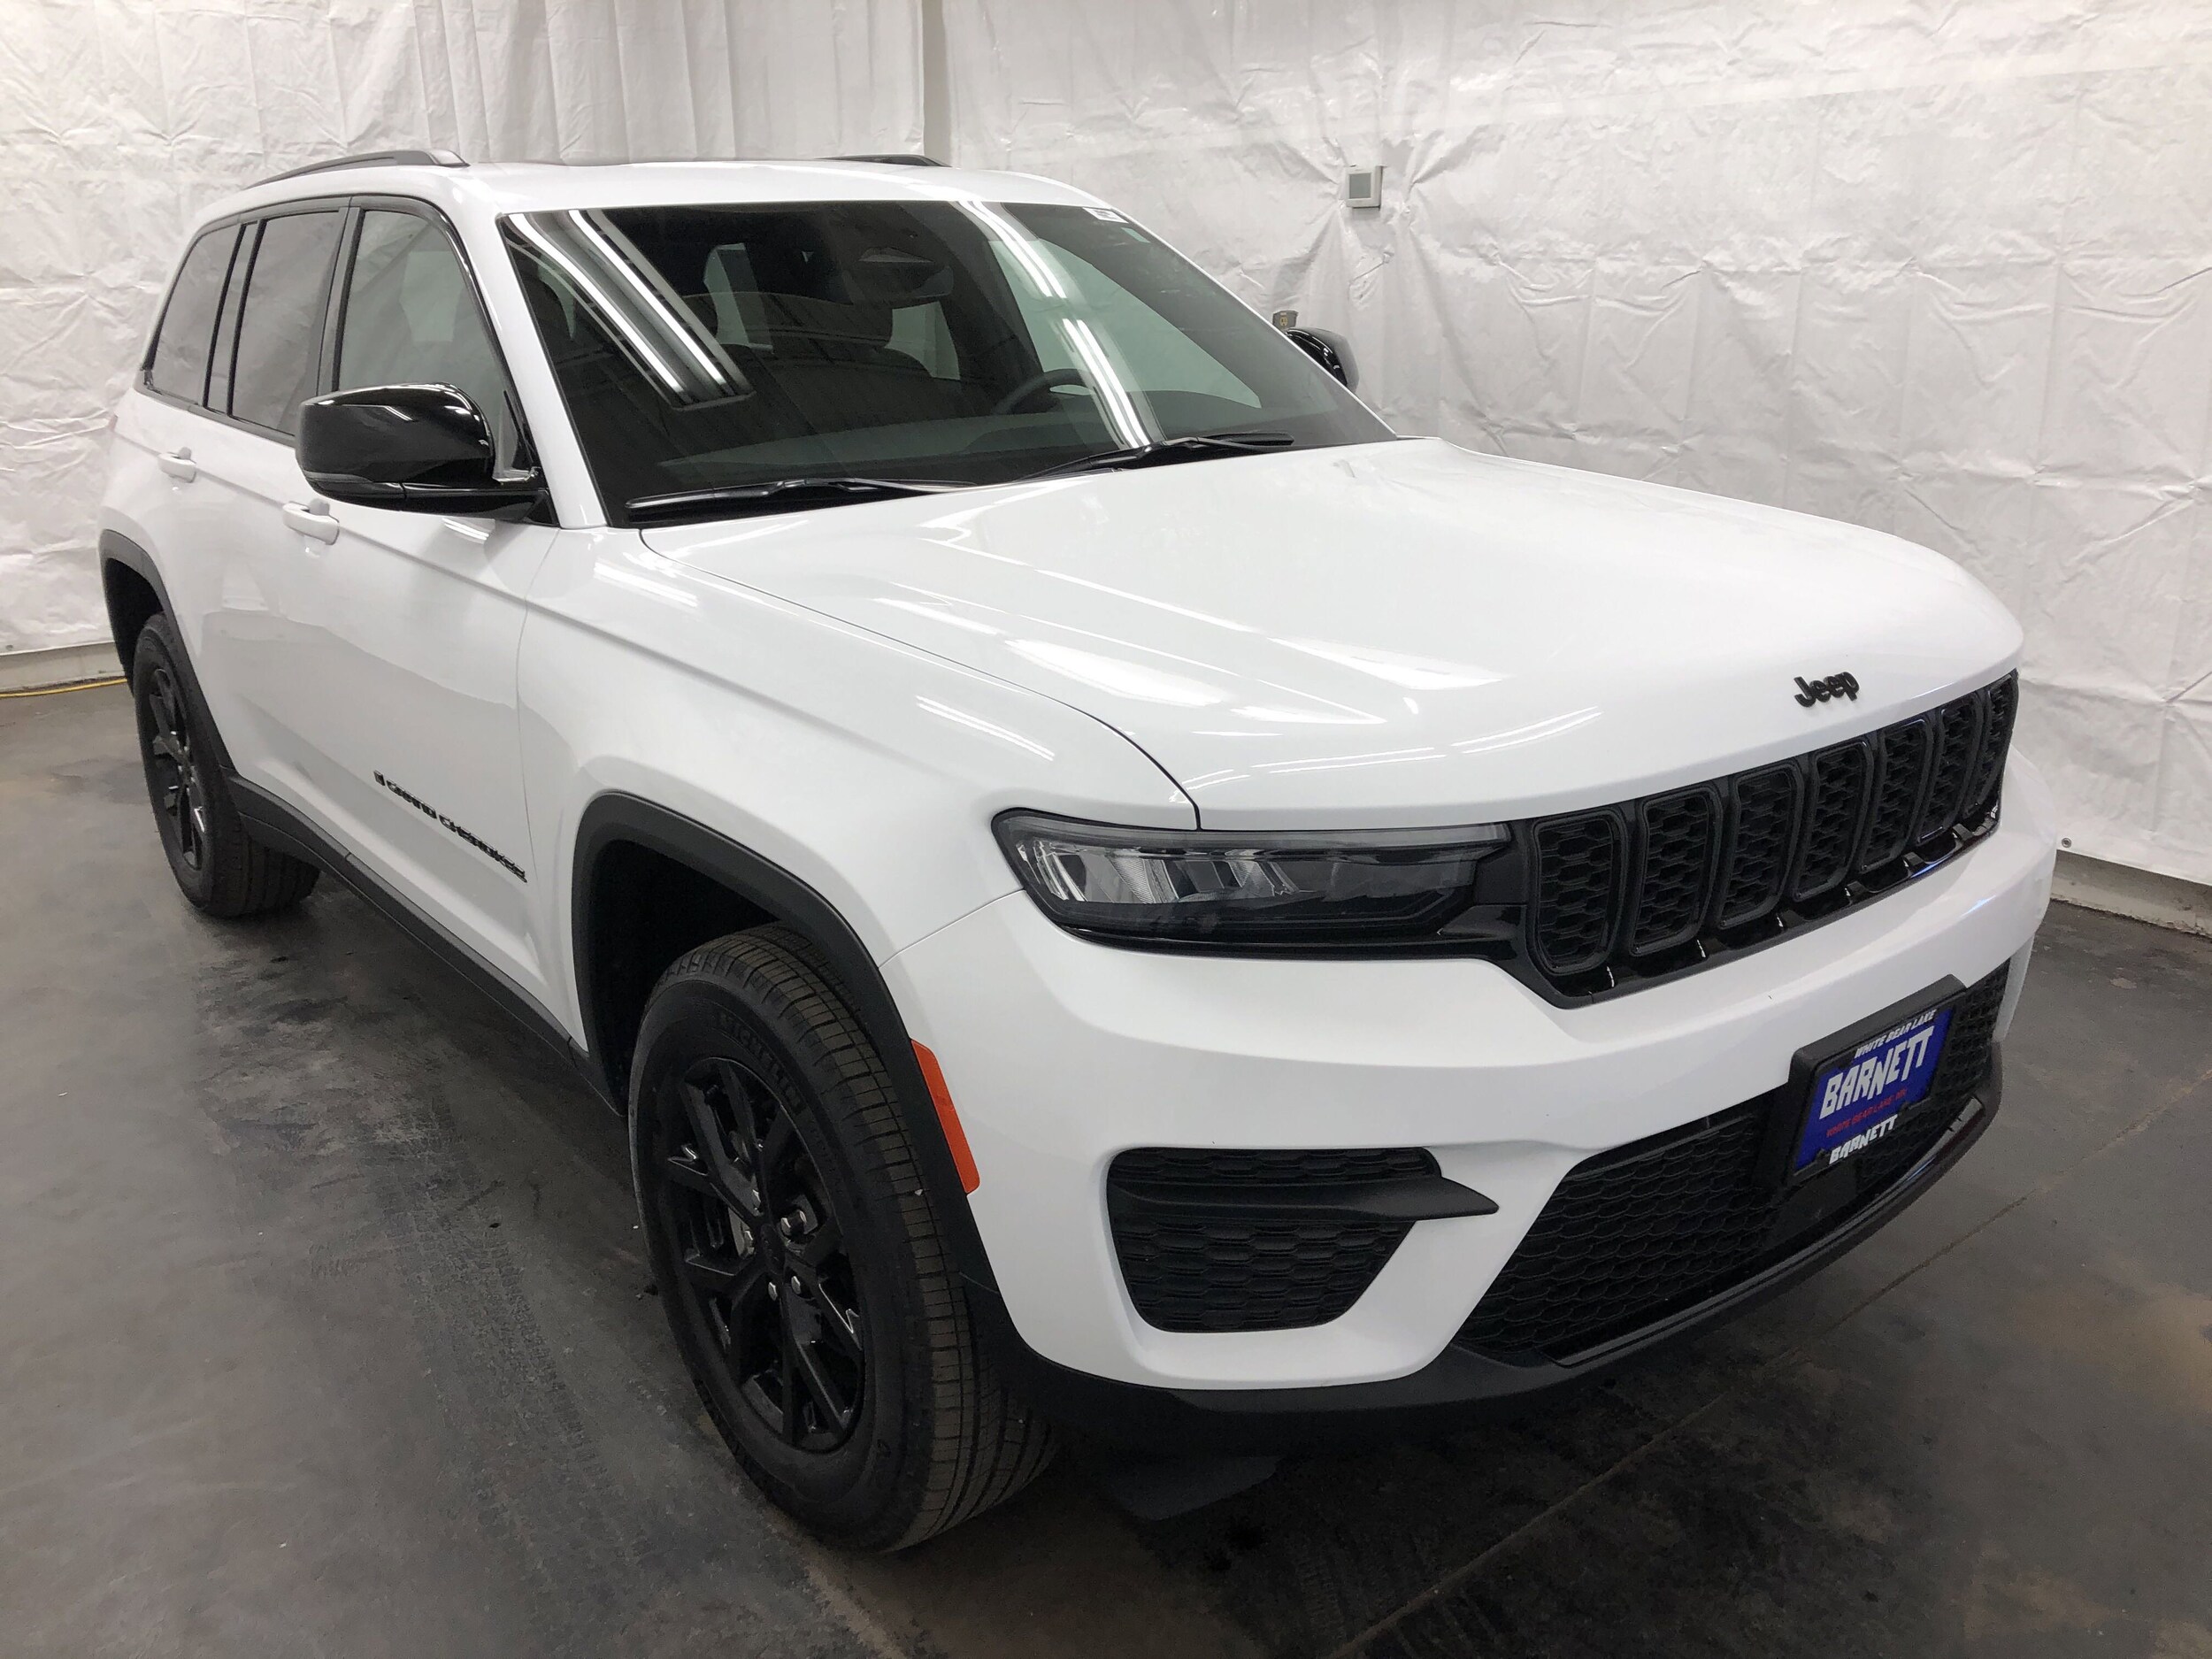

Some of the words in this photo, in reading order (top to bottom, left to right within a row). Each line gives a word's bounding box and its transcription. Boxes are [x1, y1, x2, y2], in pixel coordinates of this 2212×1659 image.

[1793, 672, 1860, 708] Jeep
[1854, 1034, 1887, 1059] WHITE
[1885, 1022, 1912, 1043] BEAR
[1910, 1009, 1938, 1030] LAKE
[718, 1010, 806, 1116] MICHELIN
[1819, 1025, 1935, 1120] BARNETT
[1829, 1114, 1898, 1164] BARNETT
